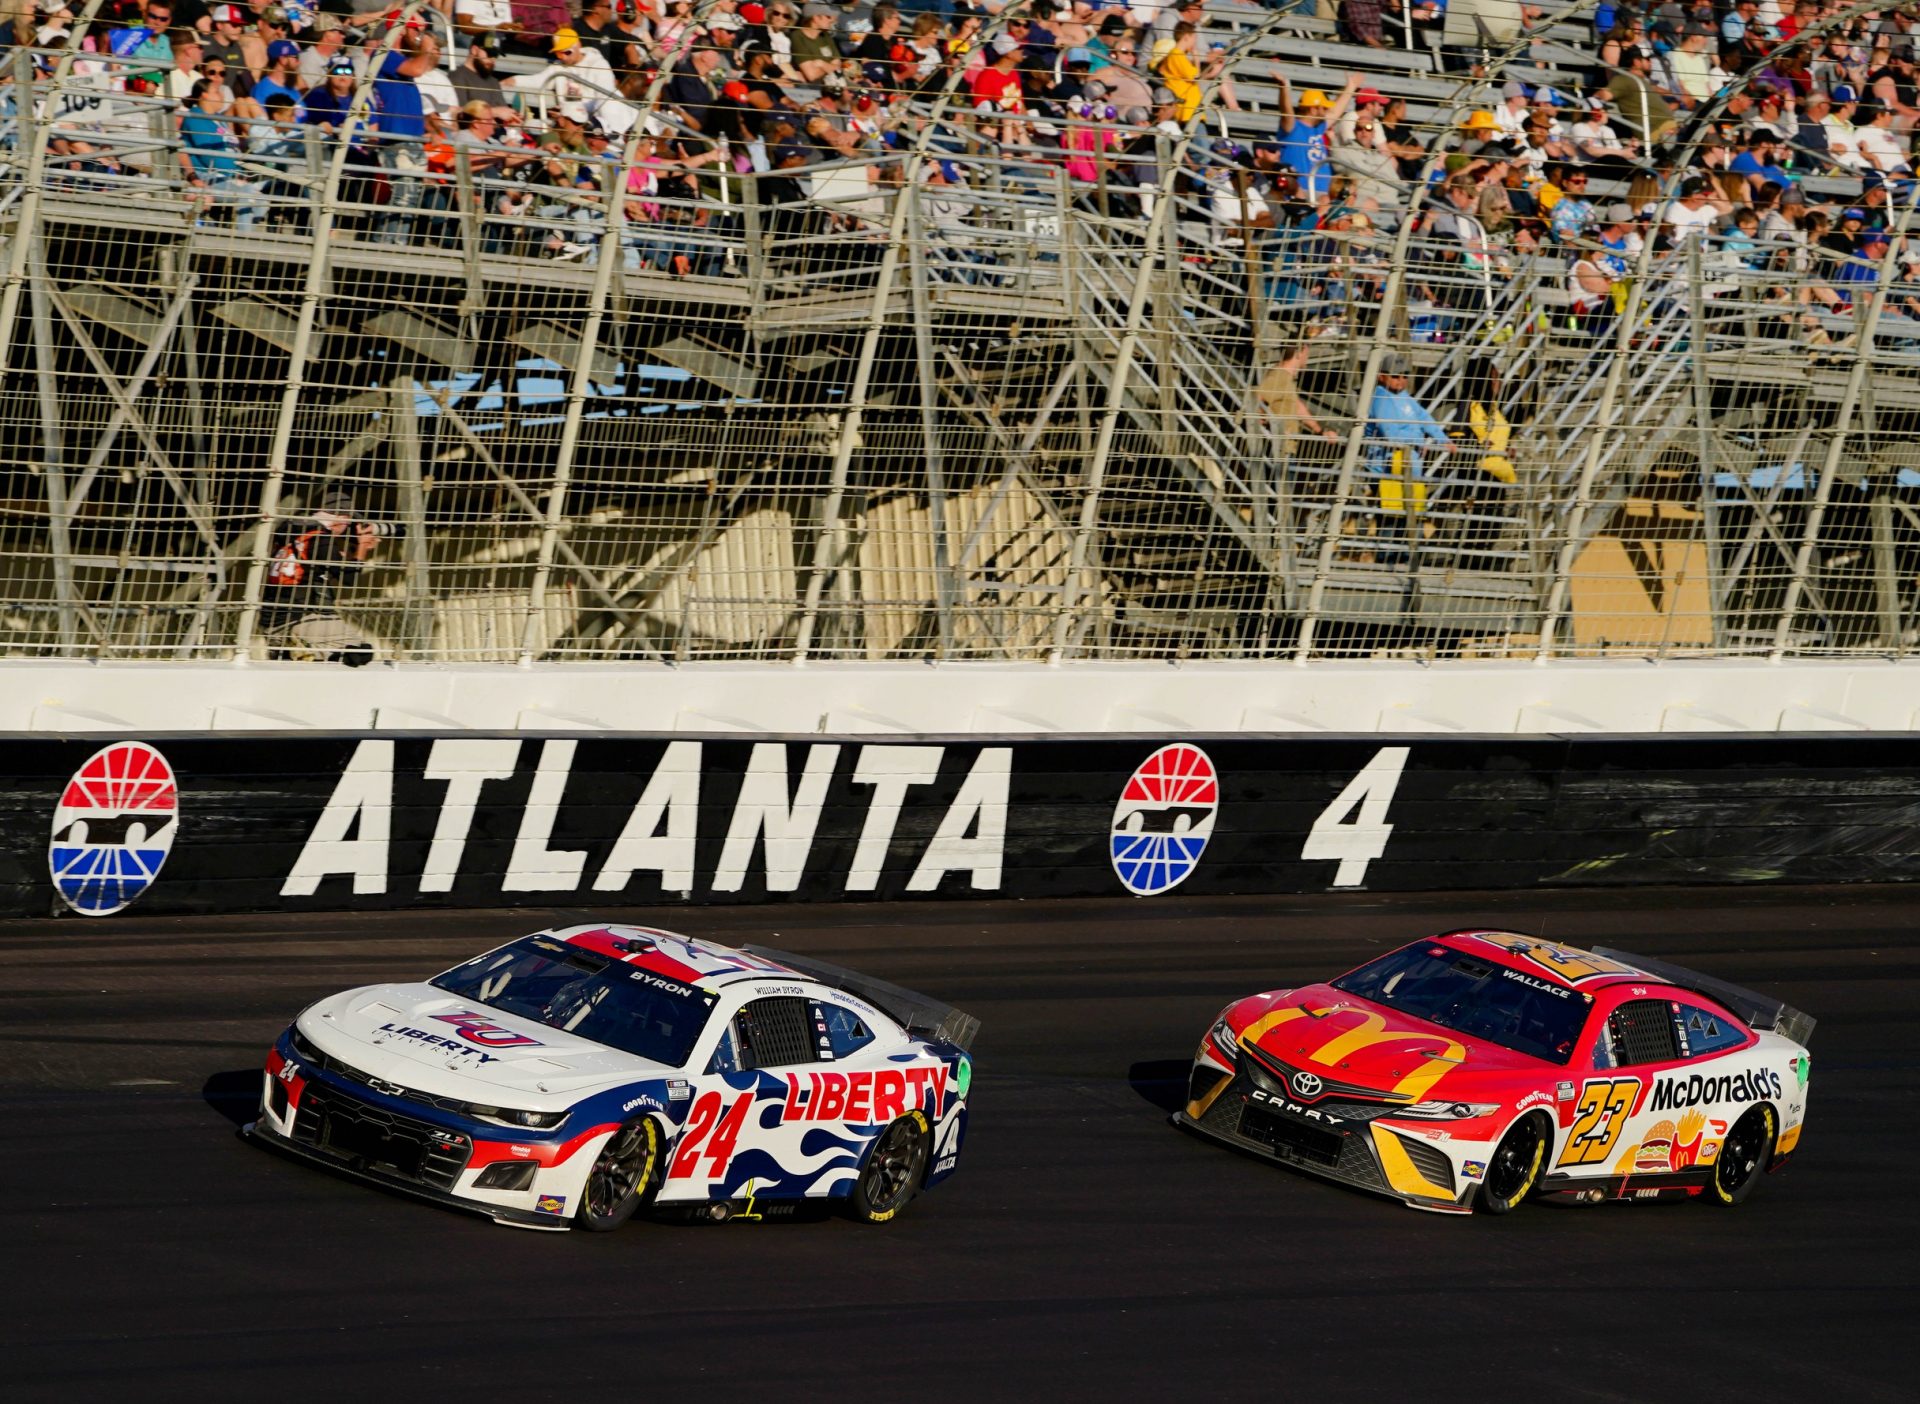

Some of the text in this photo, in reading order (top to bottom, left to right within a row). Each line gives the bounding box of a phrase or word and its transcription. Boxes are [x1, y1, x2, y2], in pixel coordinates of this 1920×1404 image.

[280, 739, 1013, 895] ATLANTA
[1302, 747, 1410, 887] 4
[629, 971, 693, 998] BYRON
[755, 987, 781, 995] WILLIAM
[1503, 969, 1571, 999] WALLACE
[372, 1029, 486, 1069] UNIVERSITY
[379, 1023, 501, 1064] LIBERTY
[279, 1059, 299, 1082] 24
[1650, 1067, 1783, 1112] McDonald's
[622, 1094, 664, 1112] GOODYEAR
[782, 1067, 949, 1121] LIBERTY
[1252, 1090, 1345, 1125] CAMRY
[1515, 1090, 1554, 1111] GOODYEAR
[668, 1090, 756, 1179] 24
[1555, 1077, 1643, 1169] 23
